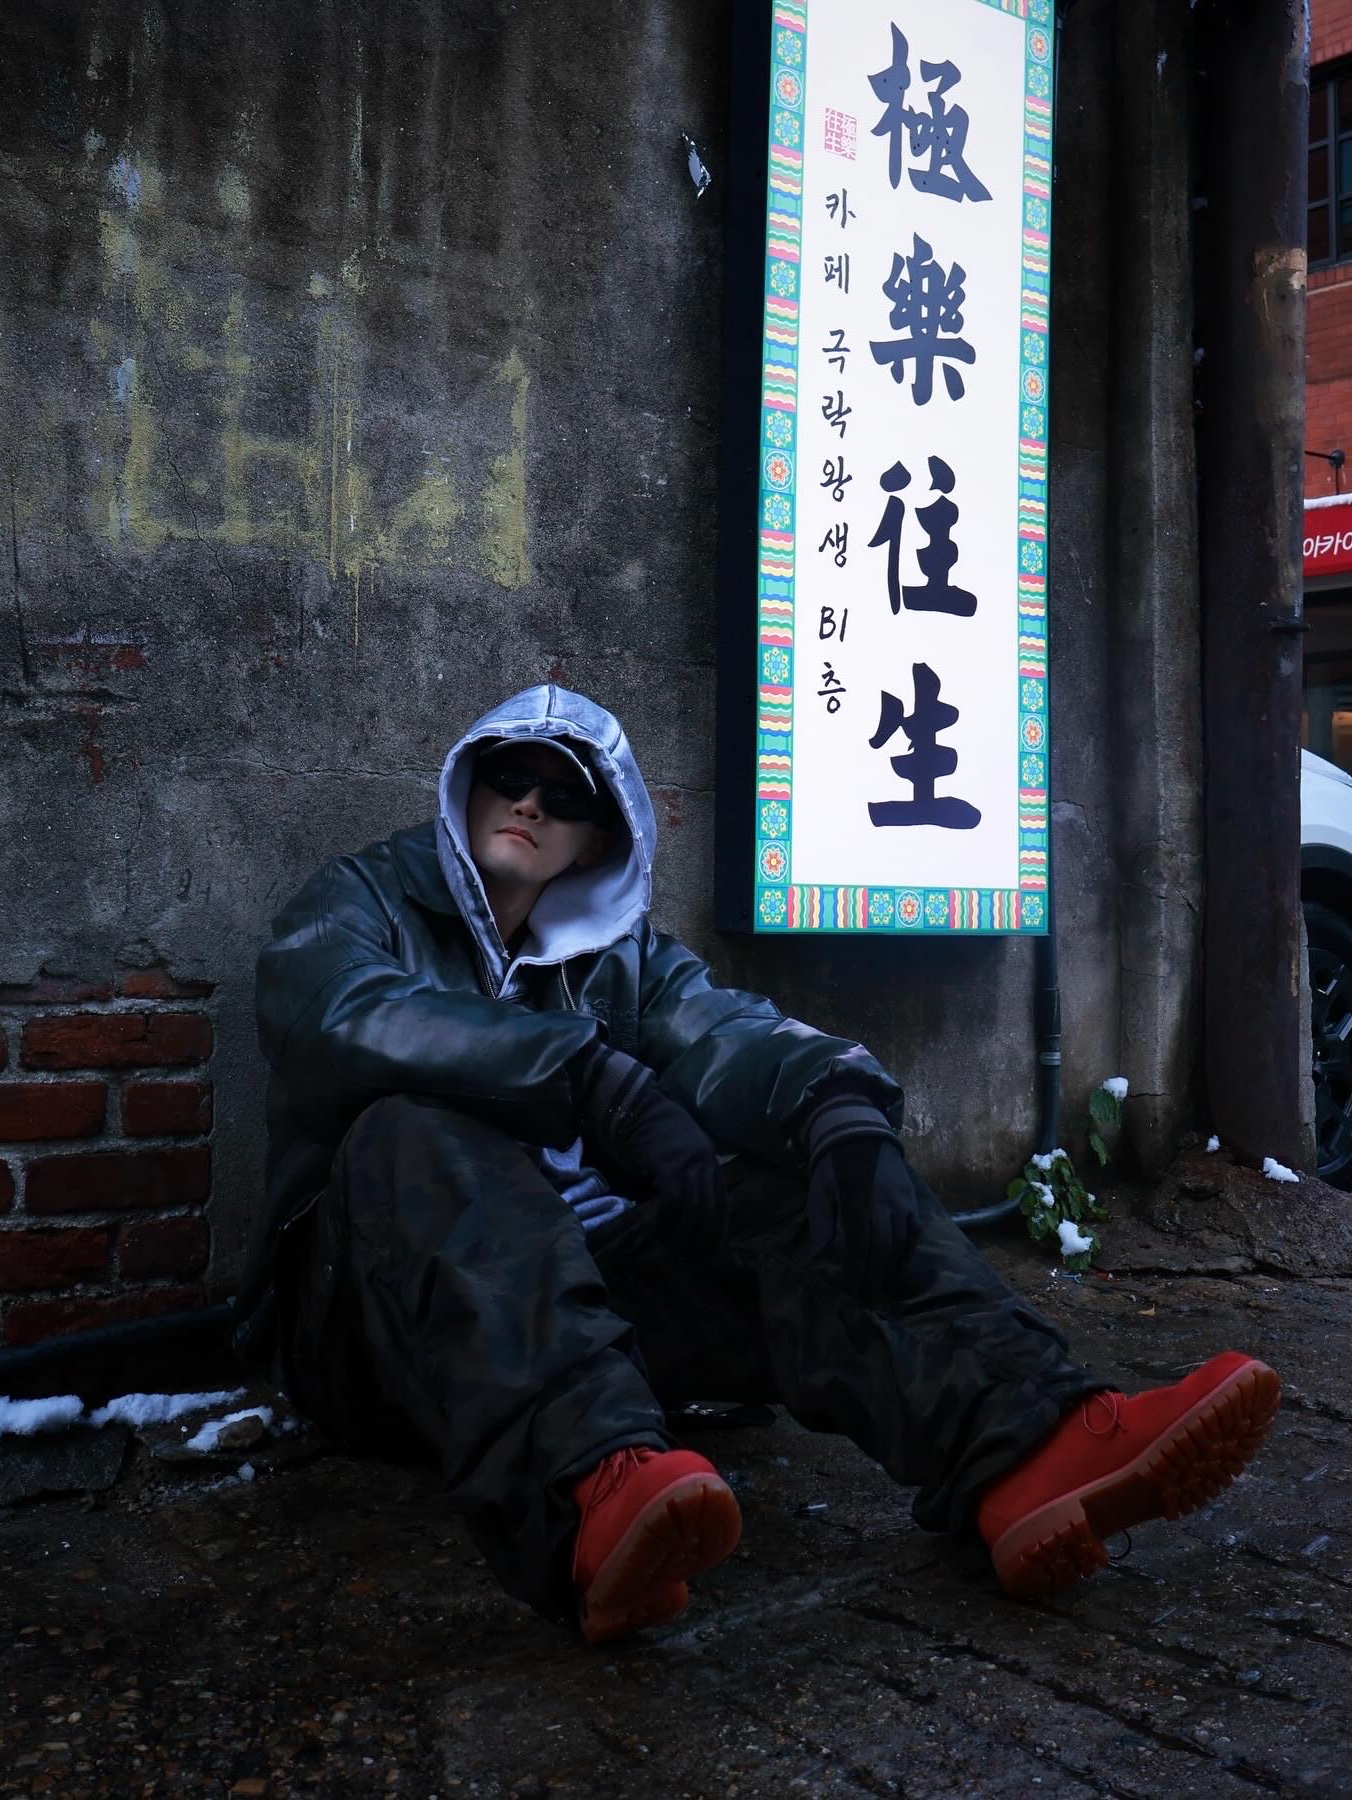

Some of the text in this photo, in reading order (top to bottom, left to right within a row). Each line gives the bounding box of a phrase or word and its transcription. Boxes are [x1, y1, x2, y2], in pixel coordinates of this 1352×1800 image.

[824, 187, 856, 294] 카페
[818, 329, 853, 569] 극락왕생
[867, 21, 994, 830] 極樂往生
